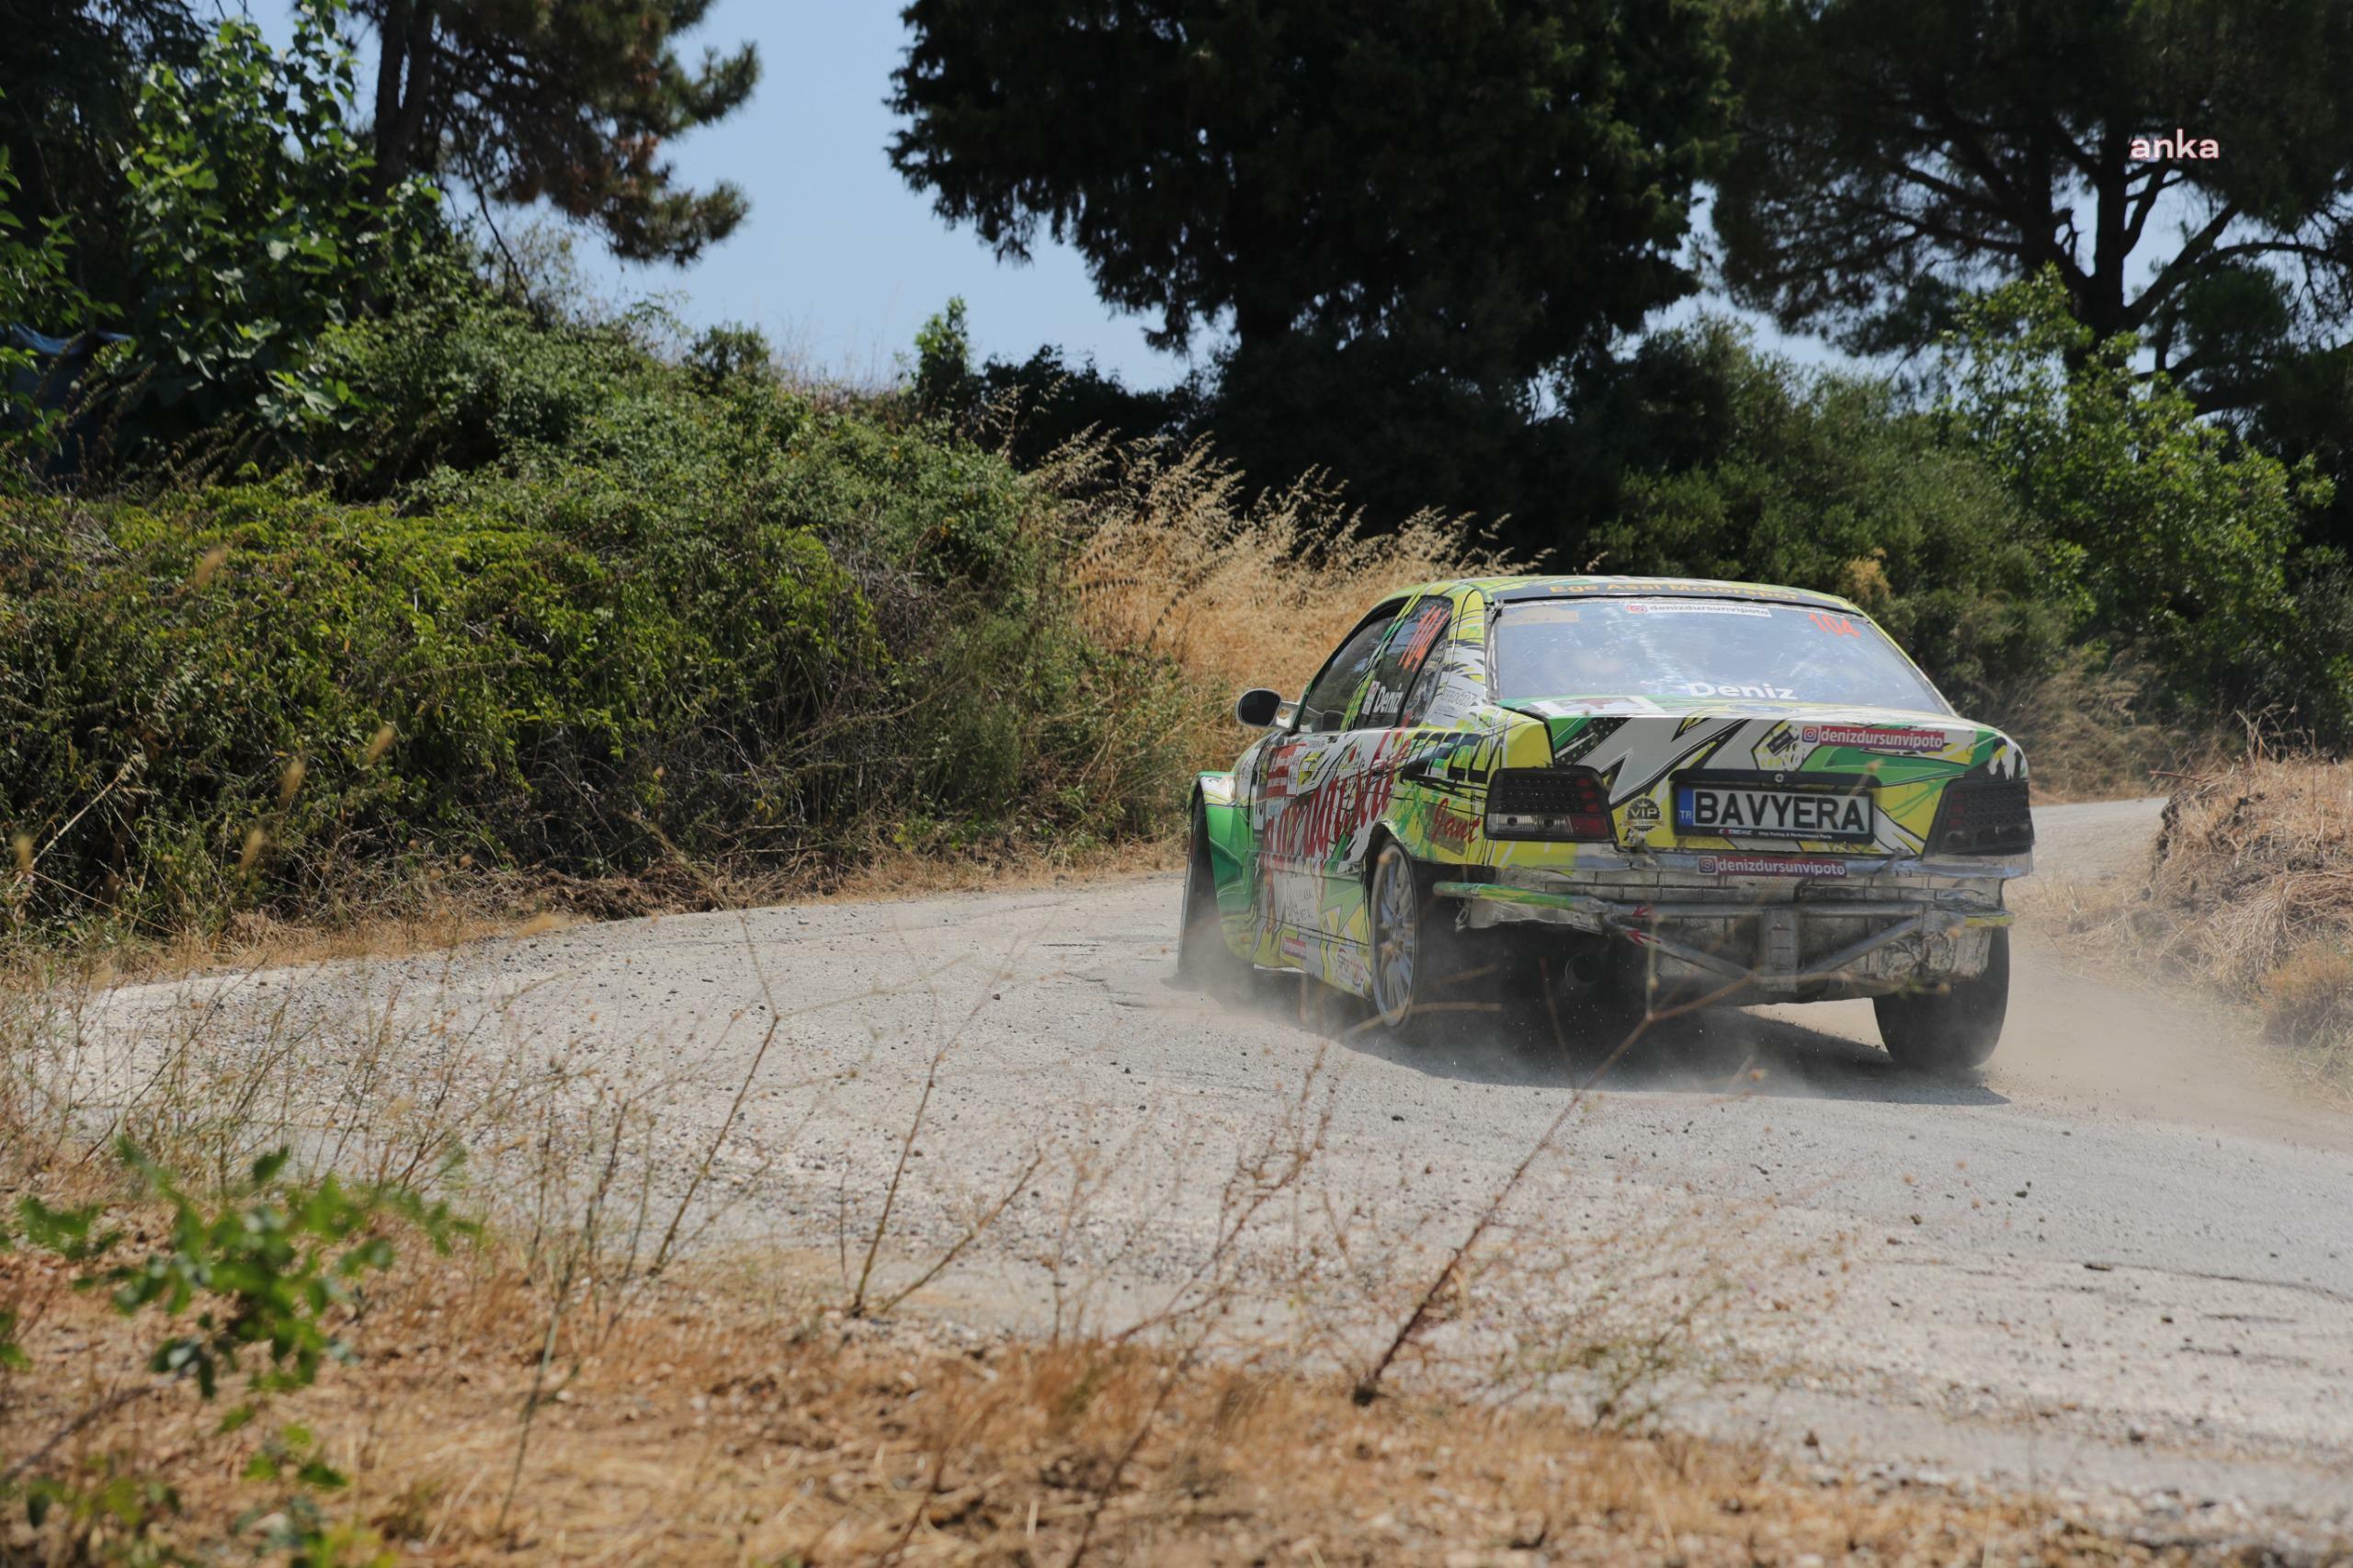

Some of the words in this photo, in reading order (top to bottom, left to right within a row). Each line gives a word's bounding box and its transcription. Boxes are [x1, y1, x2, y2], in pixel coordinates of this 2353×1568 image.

[1549, 585, 1598, 594] Ege
[1649, 604, 1769, 616] denizdursunvipoto
[1808, 612, 1861, 638] 104
[1372, 683, 1404, 714] Deniz
[1685, 681, 1798, 700] Deniz
[1821, 727, 1944, 749] denizdursunvipoto
[1631, 808, 1658, 818] VIP
[1679, 810, 1692, 820] TR
[1695, 791, 1866, 832] BAVYERA
[1719, 858, 1846, 877] denizdursunvipoto
